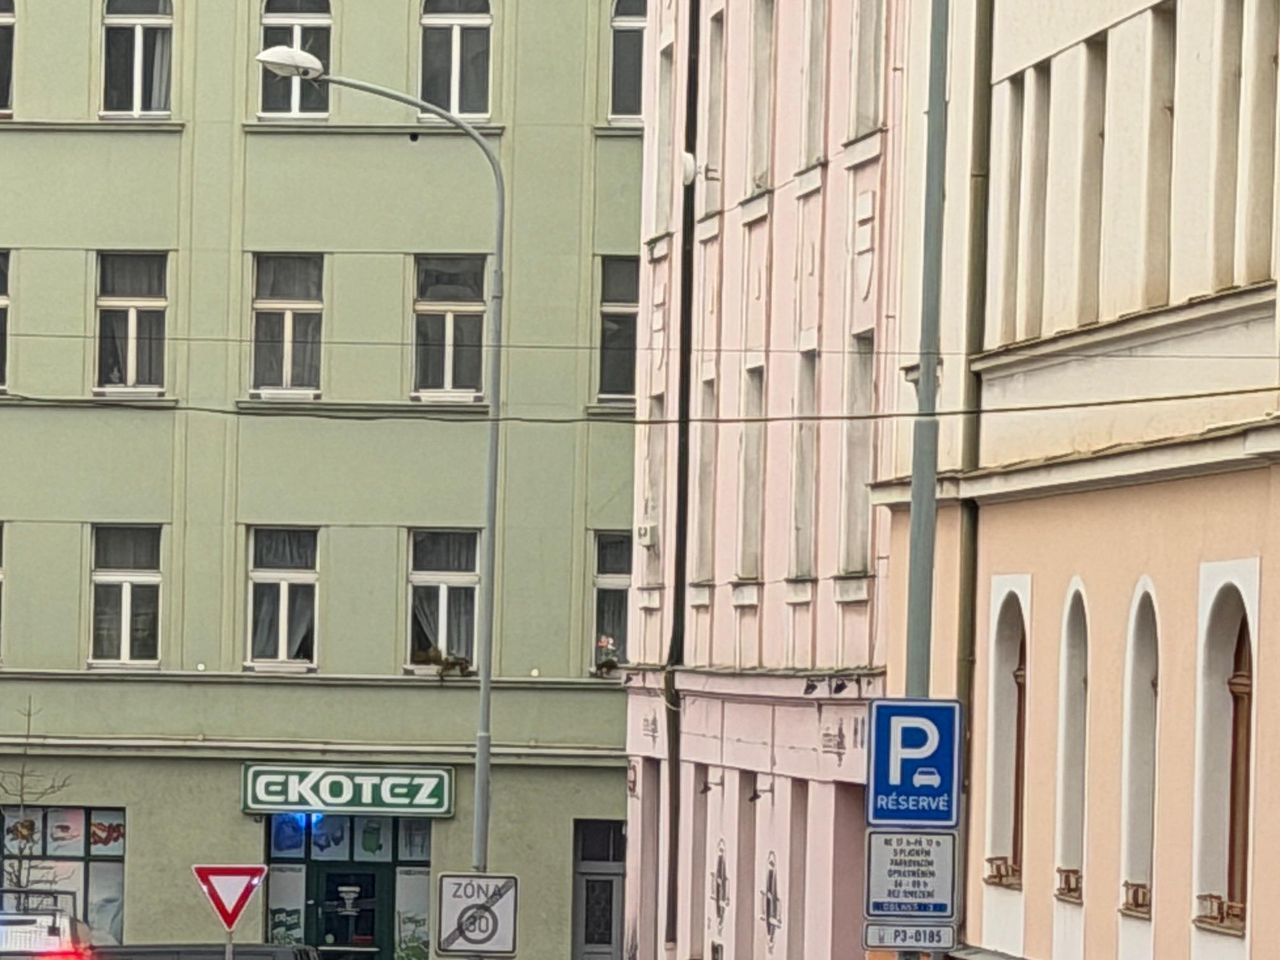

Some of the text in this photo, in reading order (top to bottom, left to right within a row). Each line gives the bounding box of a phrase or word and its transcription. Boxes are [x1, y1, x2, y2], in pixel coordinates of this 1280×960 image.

[889, 716, 940, 785] P
[255, 770, 440, 807] EKOTEZ
[452, 881, 503, 899] ZÓNA
